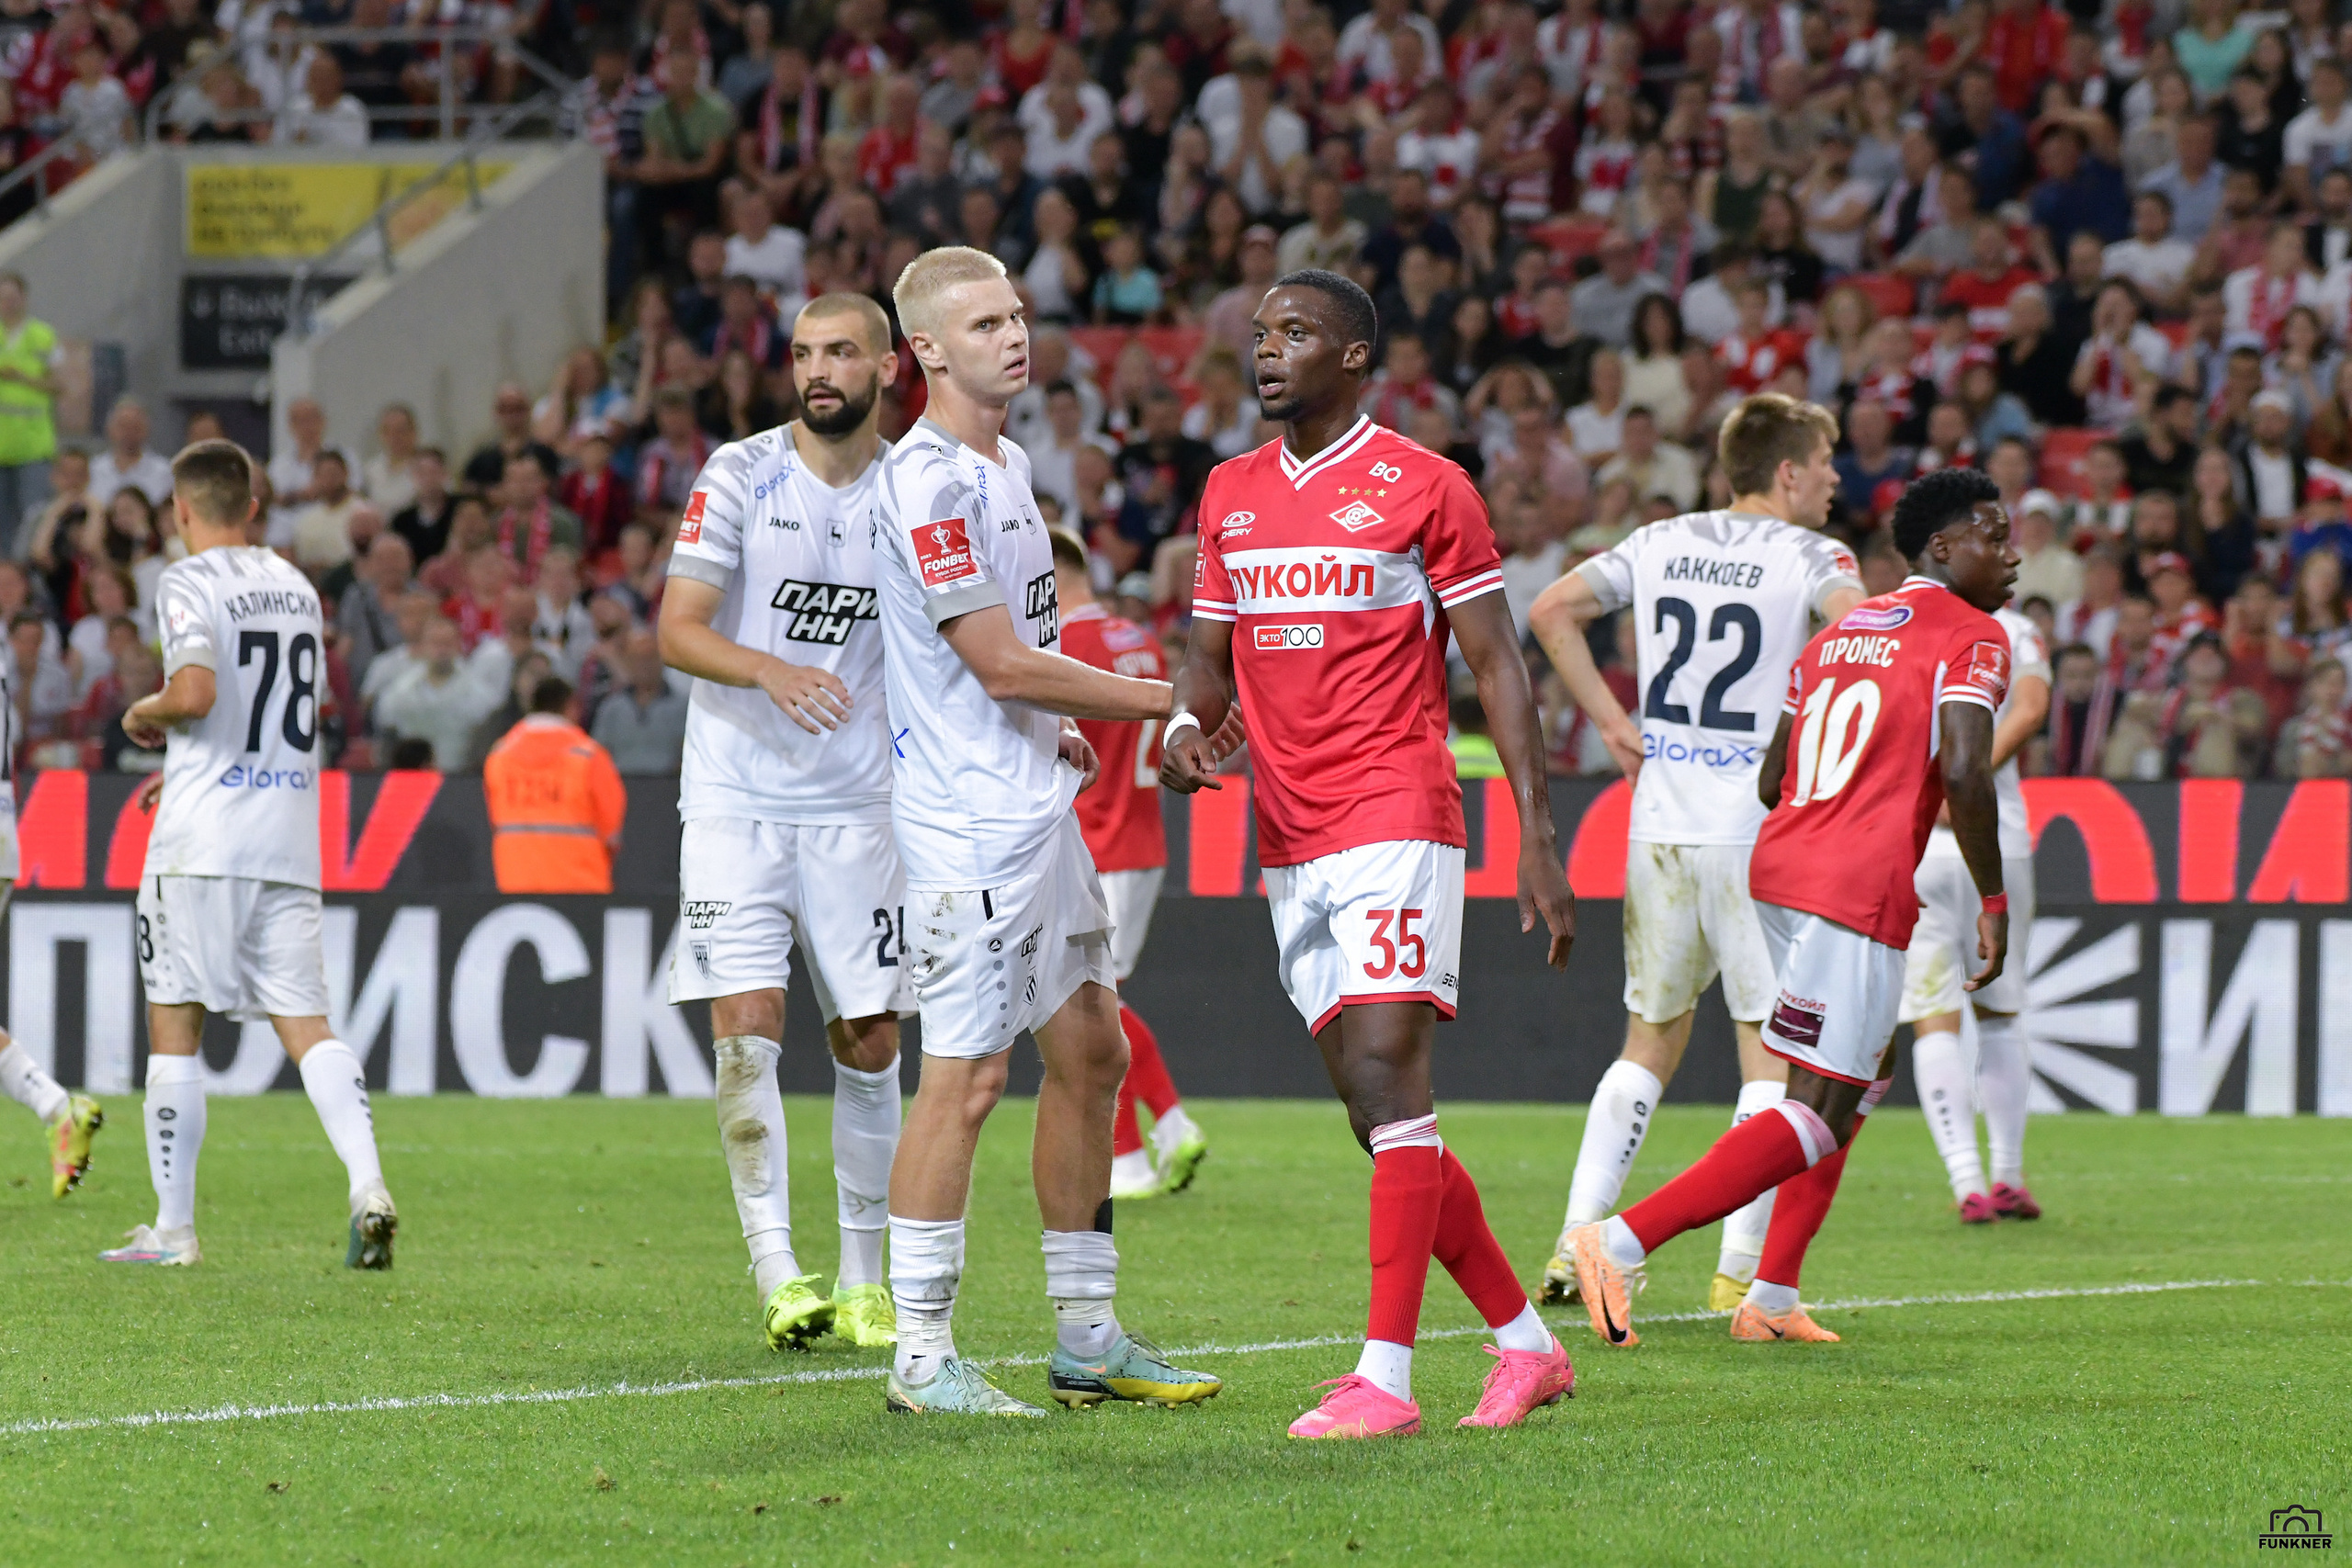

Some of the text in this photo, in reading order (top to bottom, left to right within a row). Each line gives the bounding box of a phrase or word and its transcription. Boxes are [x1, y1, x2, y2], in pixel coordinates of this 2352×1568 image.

[754, 461, 797, 500] GloraX
[1368, 460, 1402, 483] BQ
[768, 516, 800, 531] JAKO
[1221, 527, 1253, 539] CHERY
[923, 552, 969, 574] FONBET
[1227, 554, 1374, 601] ЛУКОЙЛ
[1664, 557, 1763, 589] КАККОЕВ
[775, 581, 879, 618] ПАРИ
[1026, 575, 1057, 616] ПАР
[789, 613, 852, 644] НН
[1259, 626, 1322, 647] ЭКТО 100
[1645, 596, 1761, 732] 22
[1817, 636, 1901, 669] ПРОМЕС
[238, 630, 317, 754] 78
[1789, 676, 1881, 807] 10
[684, 901, 732, 916] ПАРИ
[691, 915, 715, 929] НН
[1363, 908, 1426, 980] 35
